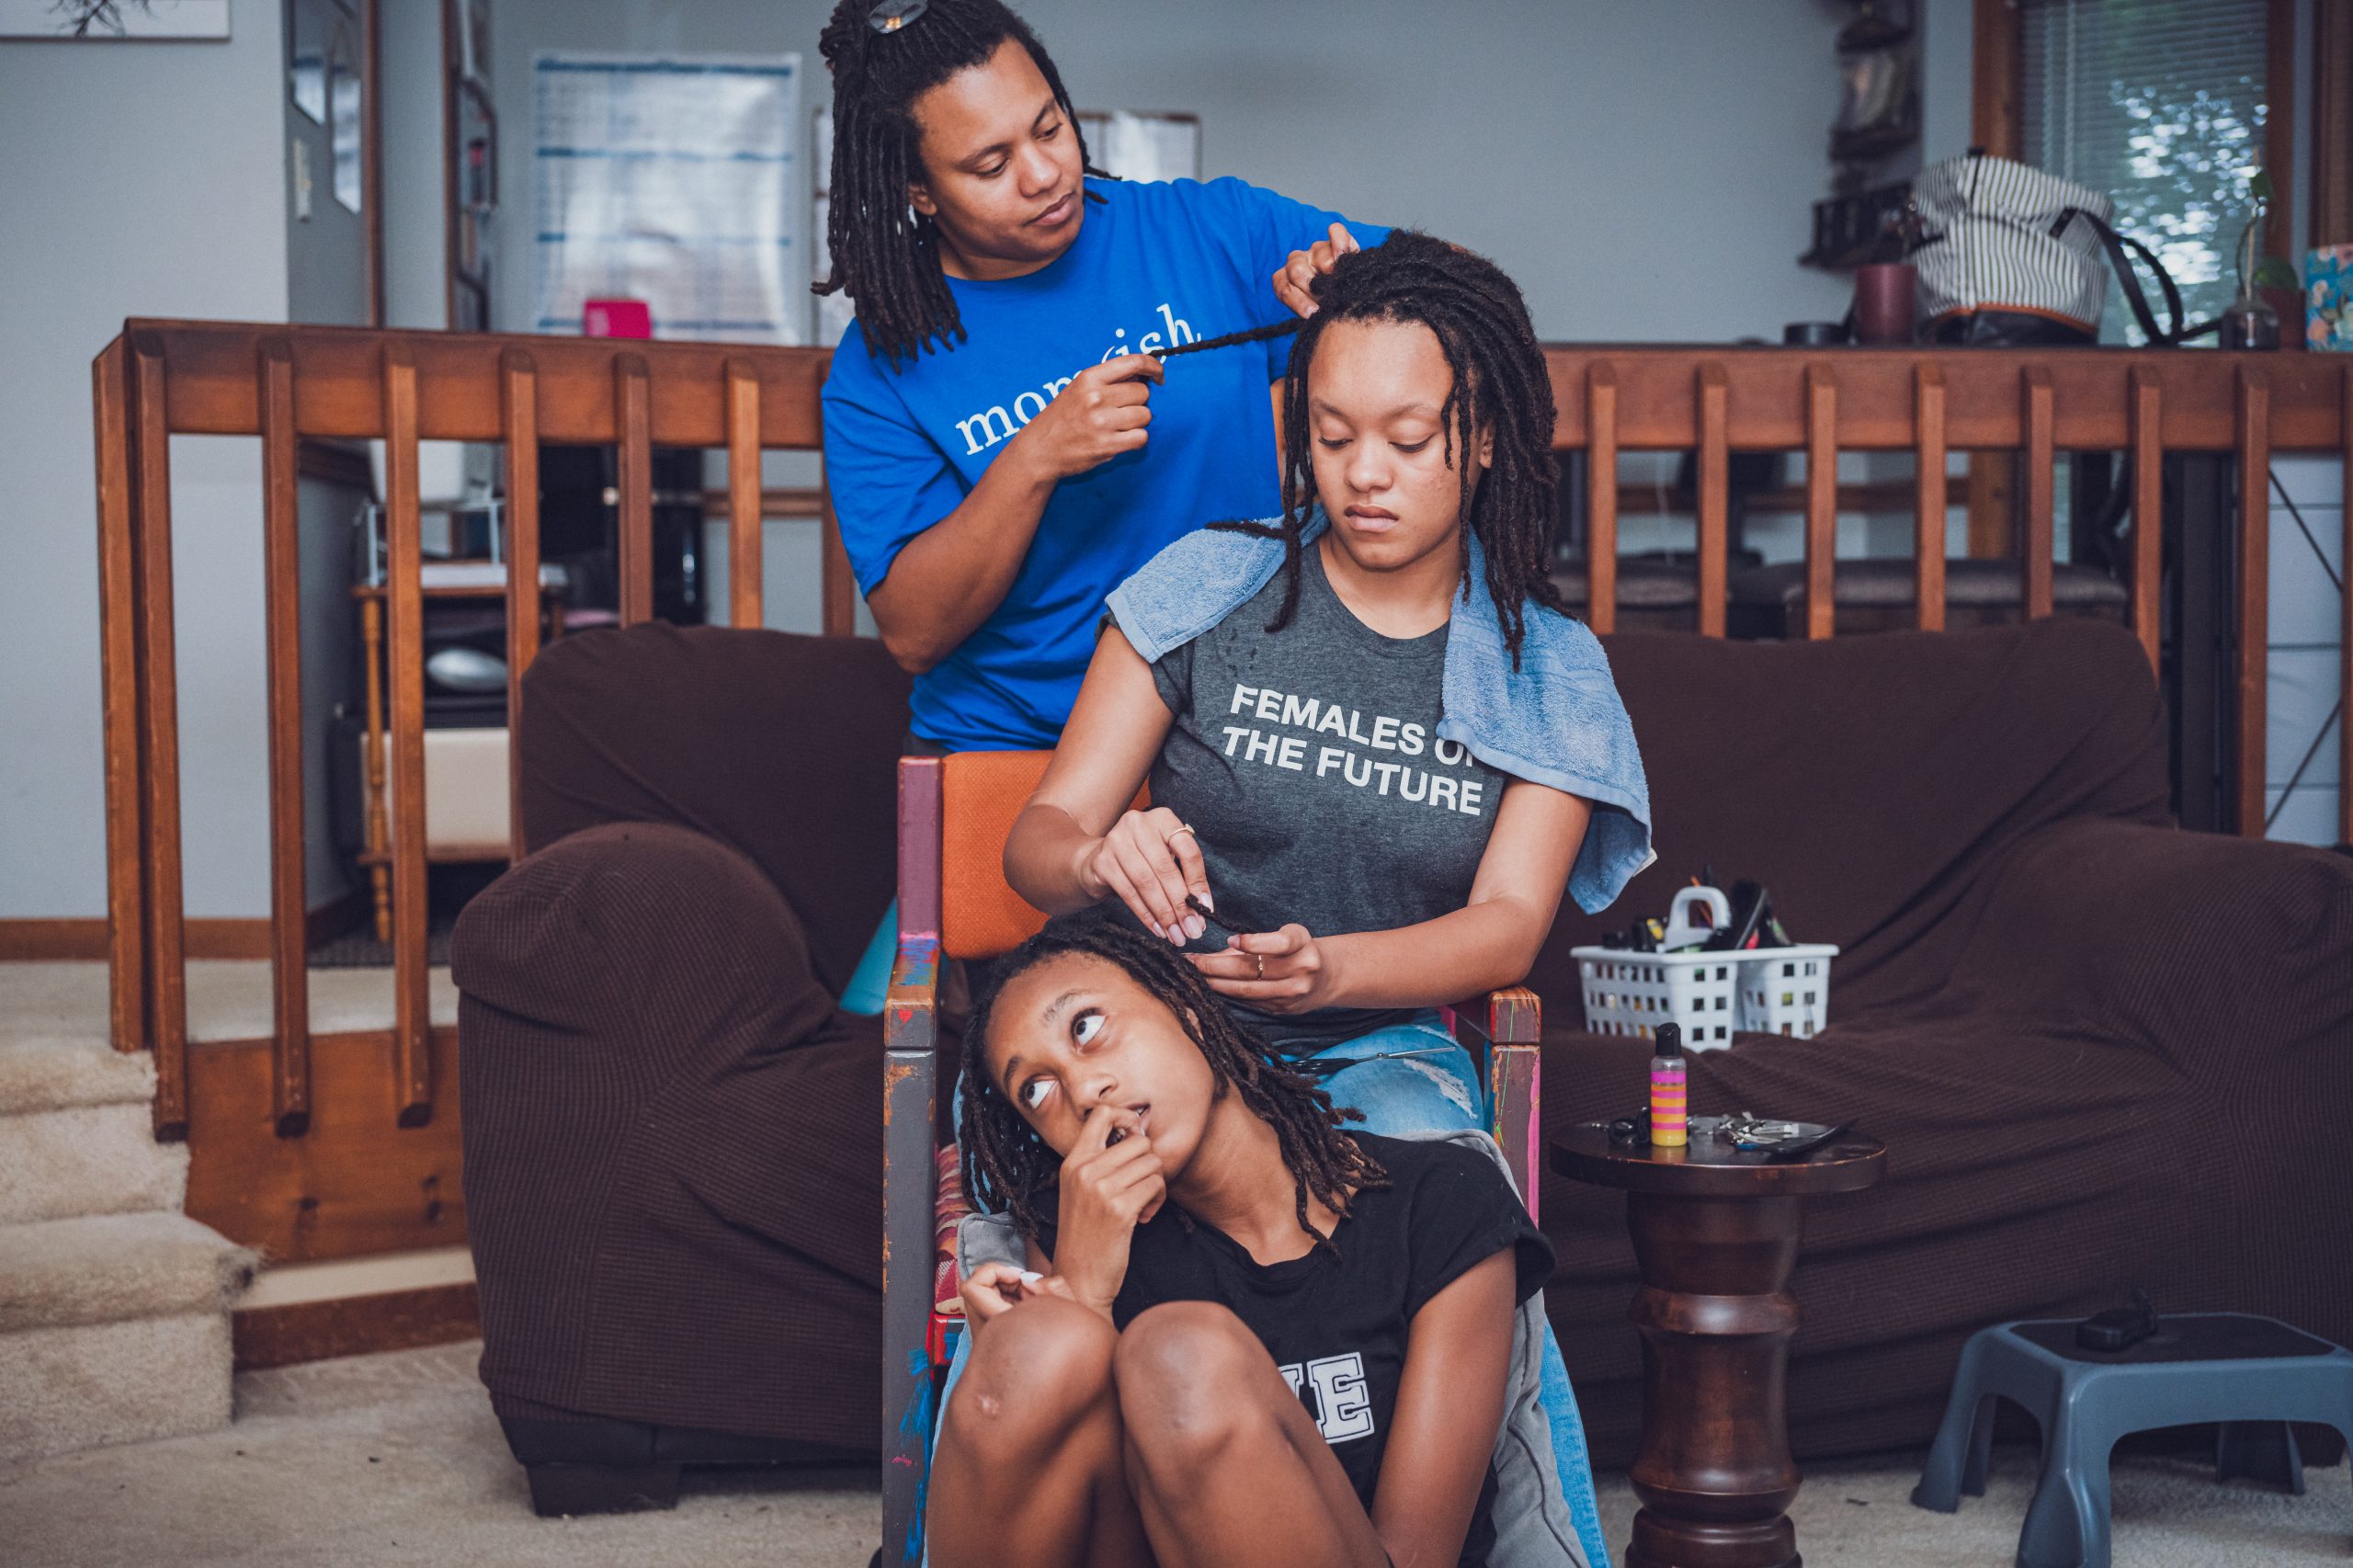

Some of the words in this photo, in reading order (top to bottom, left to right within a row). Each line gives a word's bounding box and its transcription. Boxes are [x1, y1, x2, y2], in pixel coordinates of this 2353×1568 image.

[1230, 683, 1426, 756] FEMALES
[1434, 738, 1473, 767] O
[1222, 726, 1308, 770] THE
[1316, 746, 1483, 816] FUTURE
